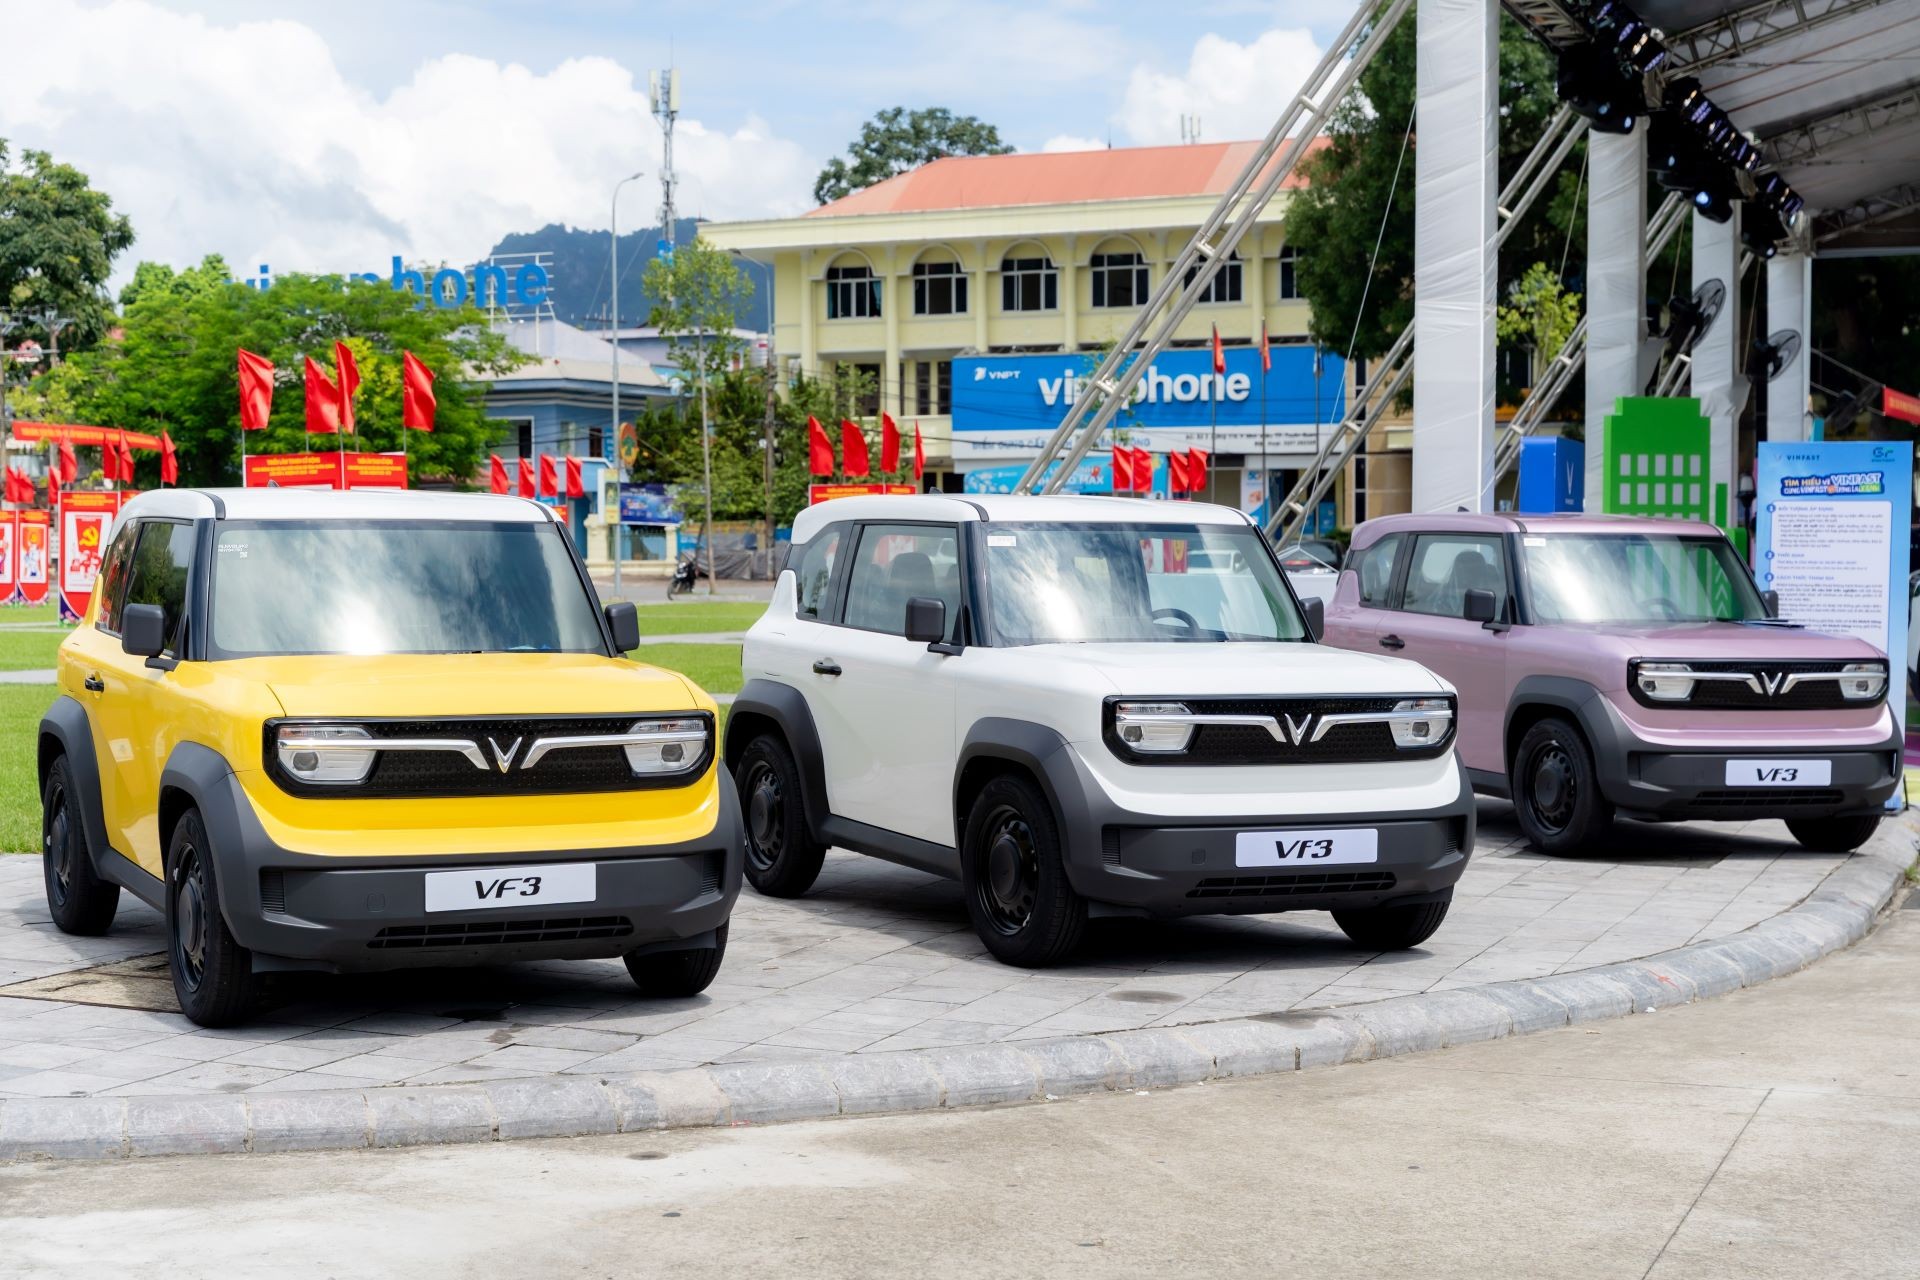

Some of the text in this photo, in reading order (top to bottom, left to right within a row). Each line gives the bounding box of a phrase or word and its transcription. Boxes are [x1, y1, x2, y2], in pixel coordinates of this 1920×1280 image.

[988, 370, 1021, 379] VNPT
[1830, 472, 1882, 487] VINFAST
[1756, 767, 1798, 782] VF3
[1275, 839, 1334, 859] VF3
[475, 876, 542, 899] VF3
